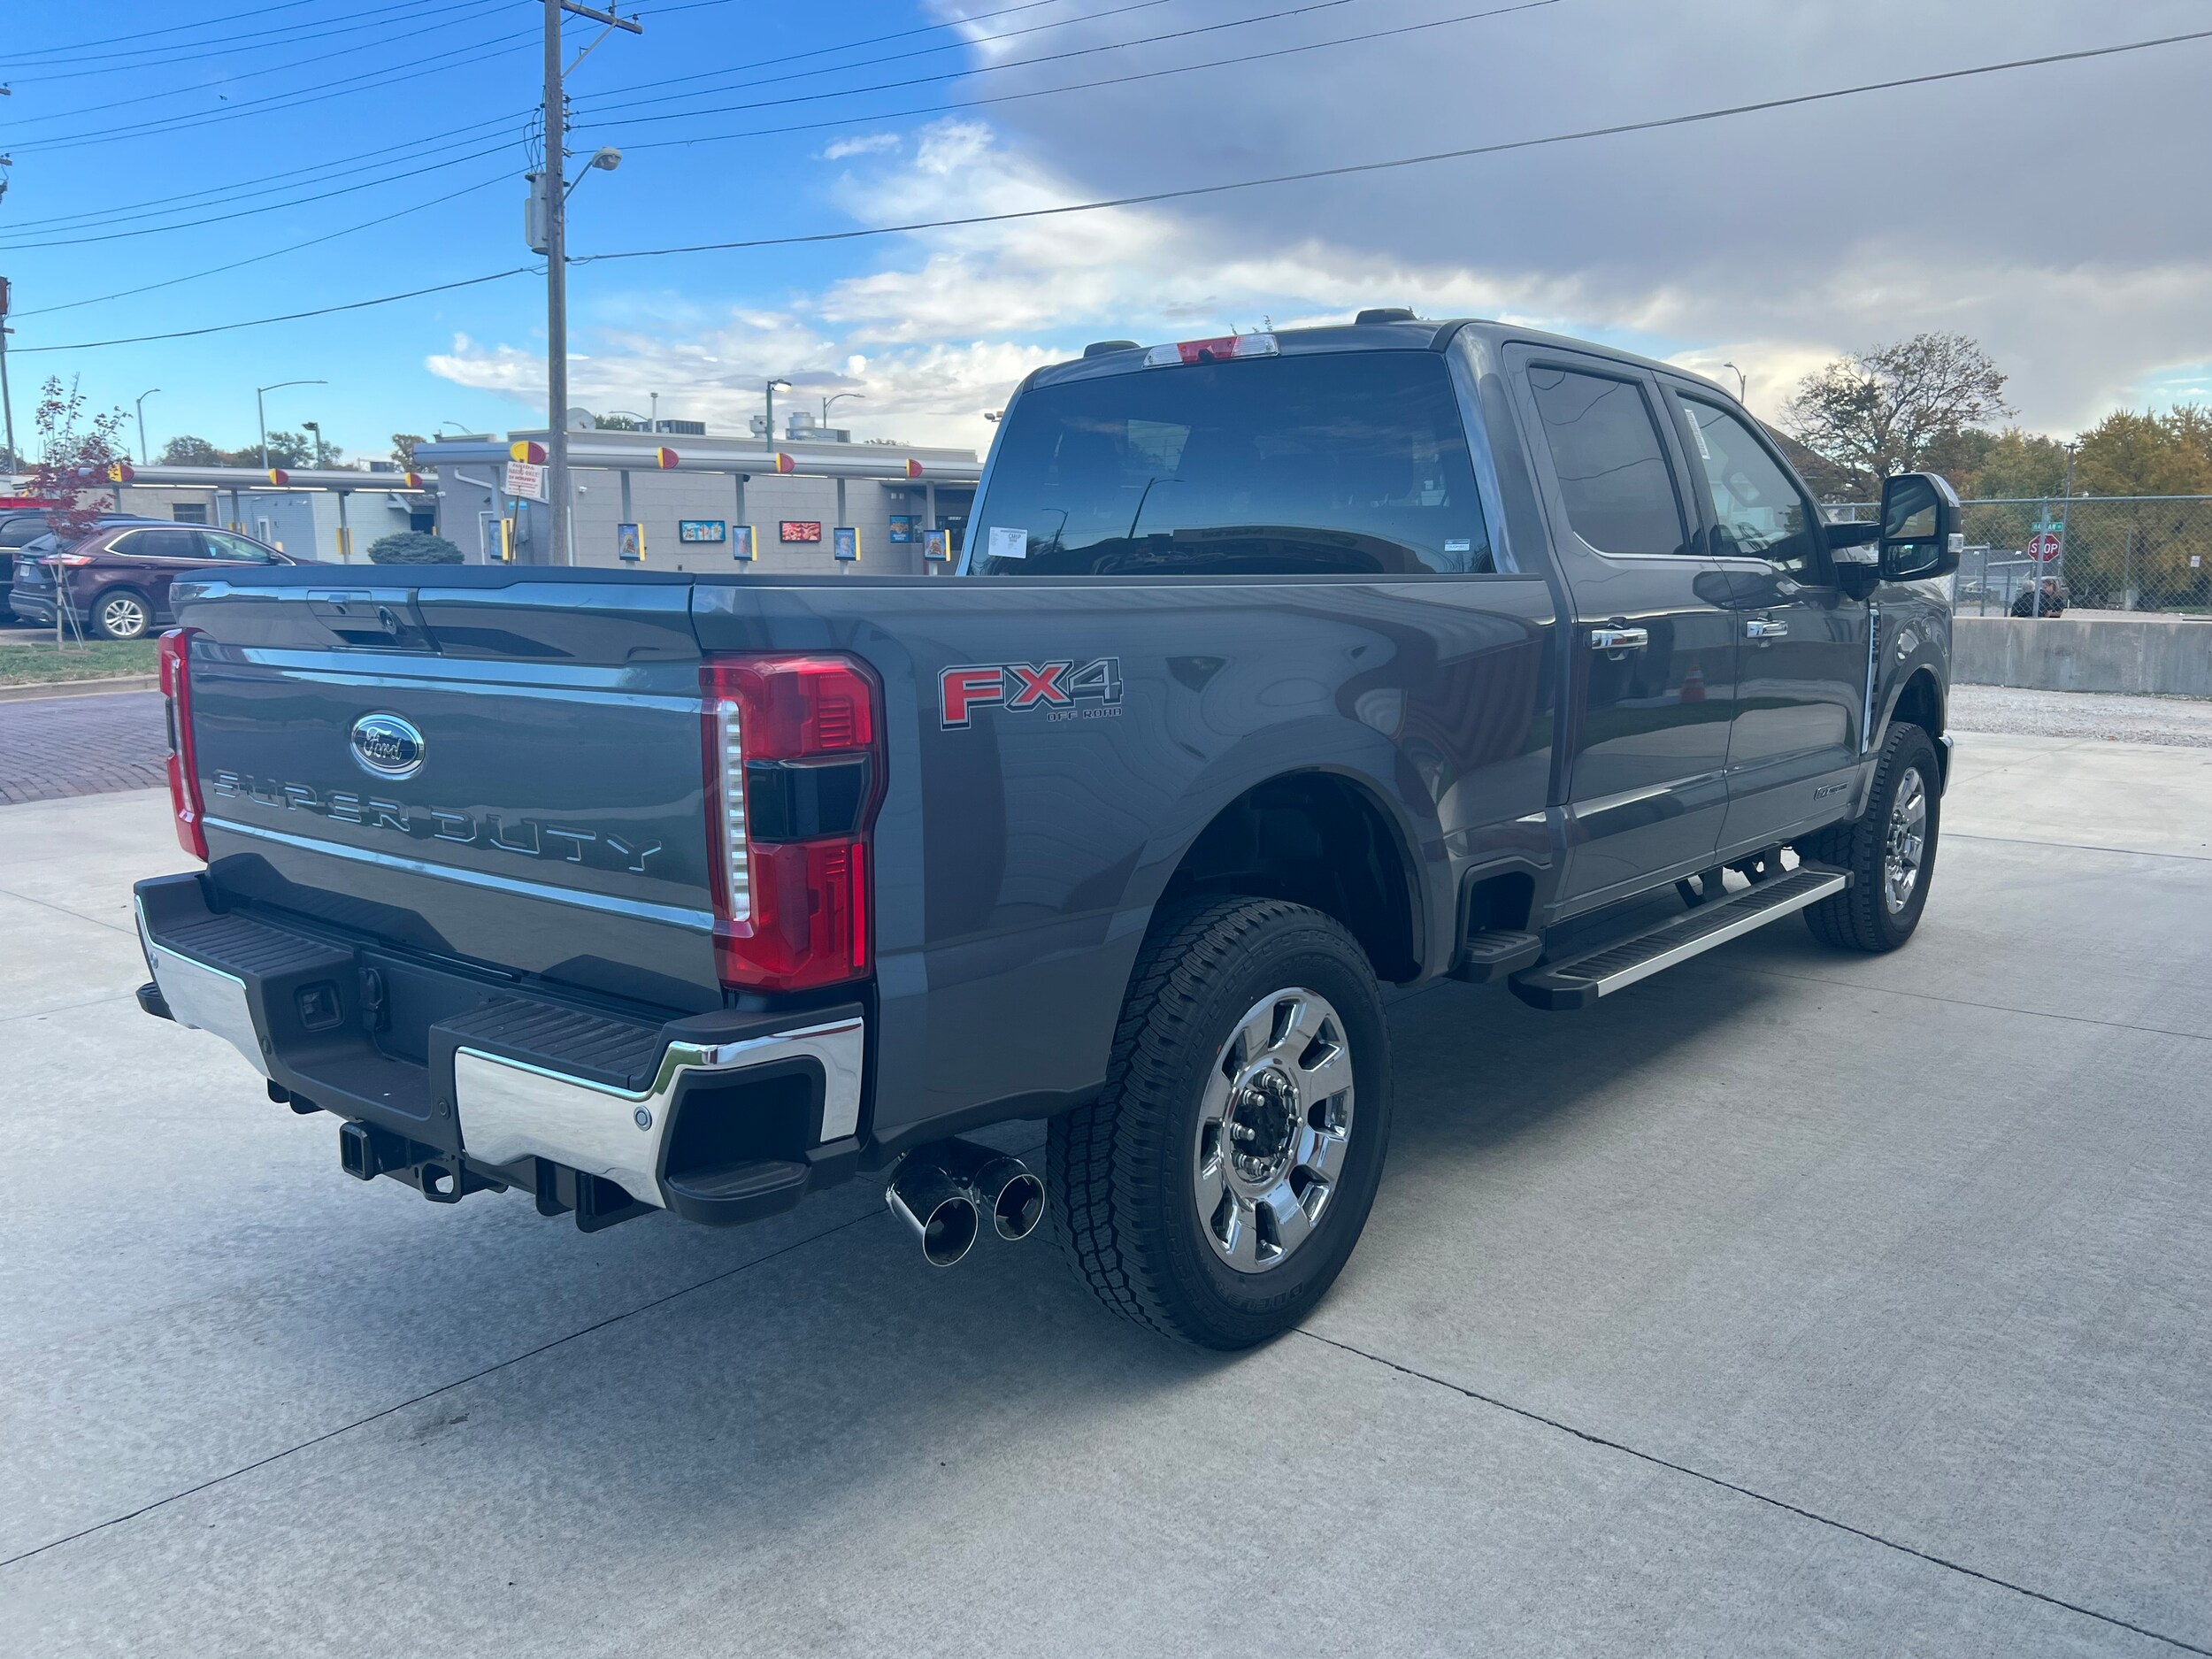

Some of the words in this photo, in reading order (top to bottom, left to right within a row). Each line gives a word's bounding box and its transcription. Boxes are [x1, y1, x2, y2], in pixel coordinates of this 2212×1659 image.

[2030, 542, 2058, 554] SOP
[937, 657, 1124, 732] FX4
[1046, 710, 1078, 722] OFF
[1083, 707, 1123, 719] ROAD
[363, 726, 404, 763] Ford
[211, 768, 412, 833] SUPER
[428, 804, 664, 872] DUTY
